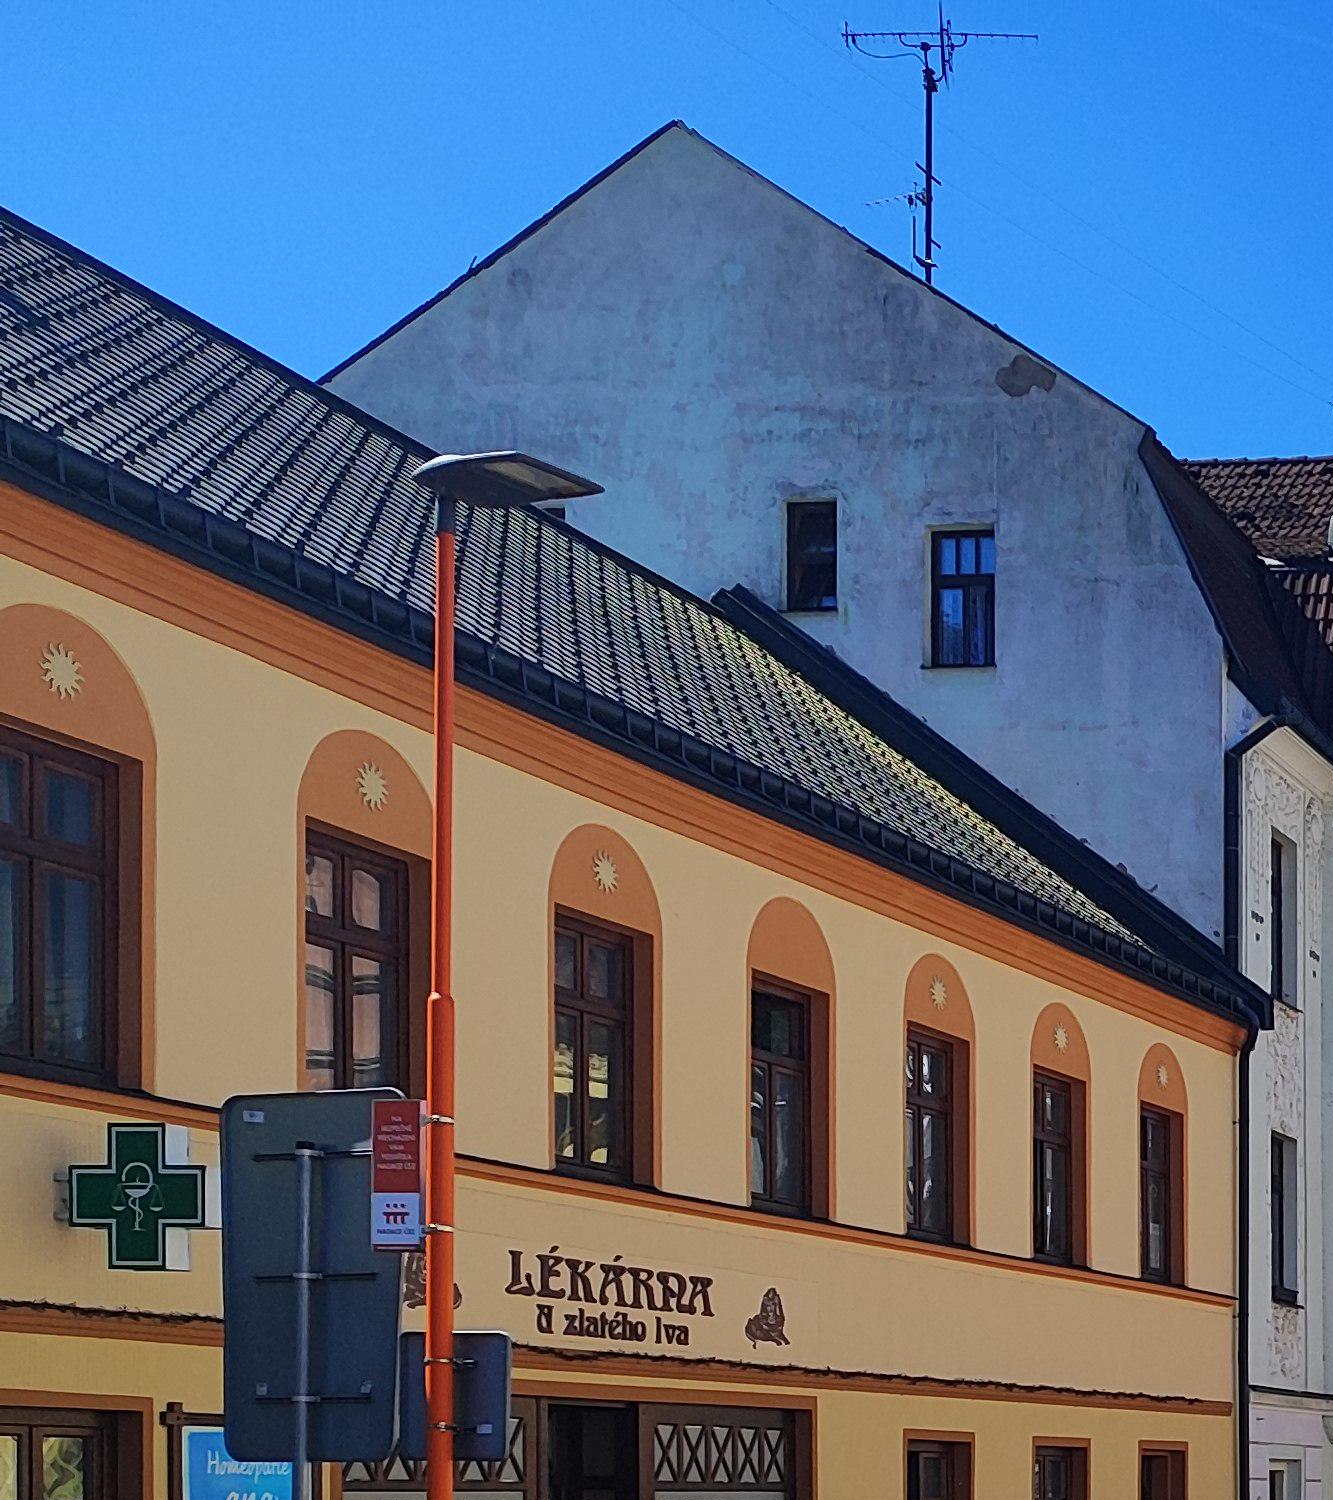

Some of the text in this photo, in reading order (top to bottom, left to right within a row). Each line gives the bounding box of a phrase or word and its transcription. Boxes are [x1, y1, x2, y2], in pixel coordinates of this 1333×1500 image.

[504, 1245, 715, 1317] LÉKÁRNA
[562, 1308, 647, 1343] zlatého
[654, 1316, 690, 1346] lva
